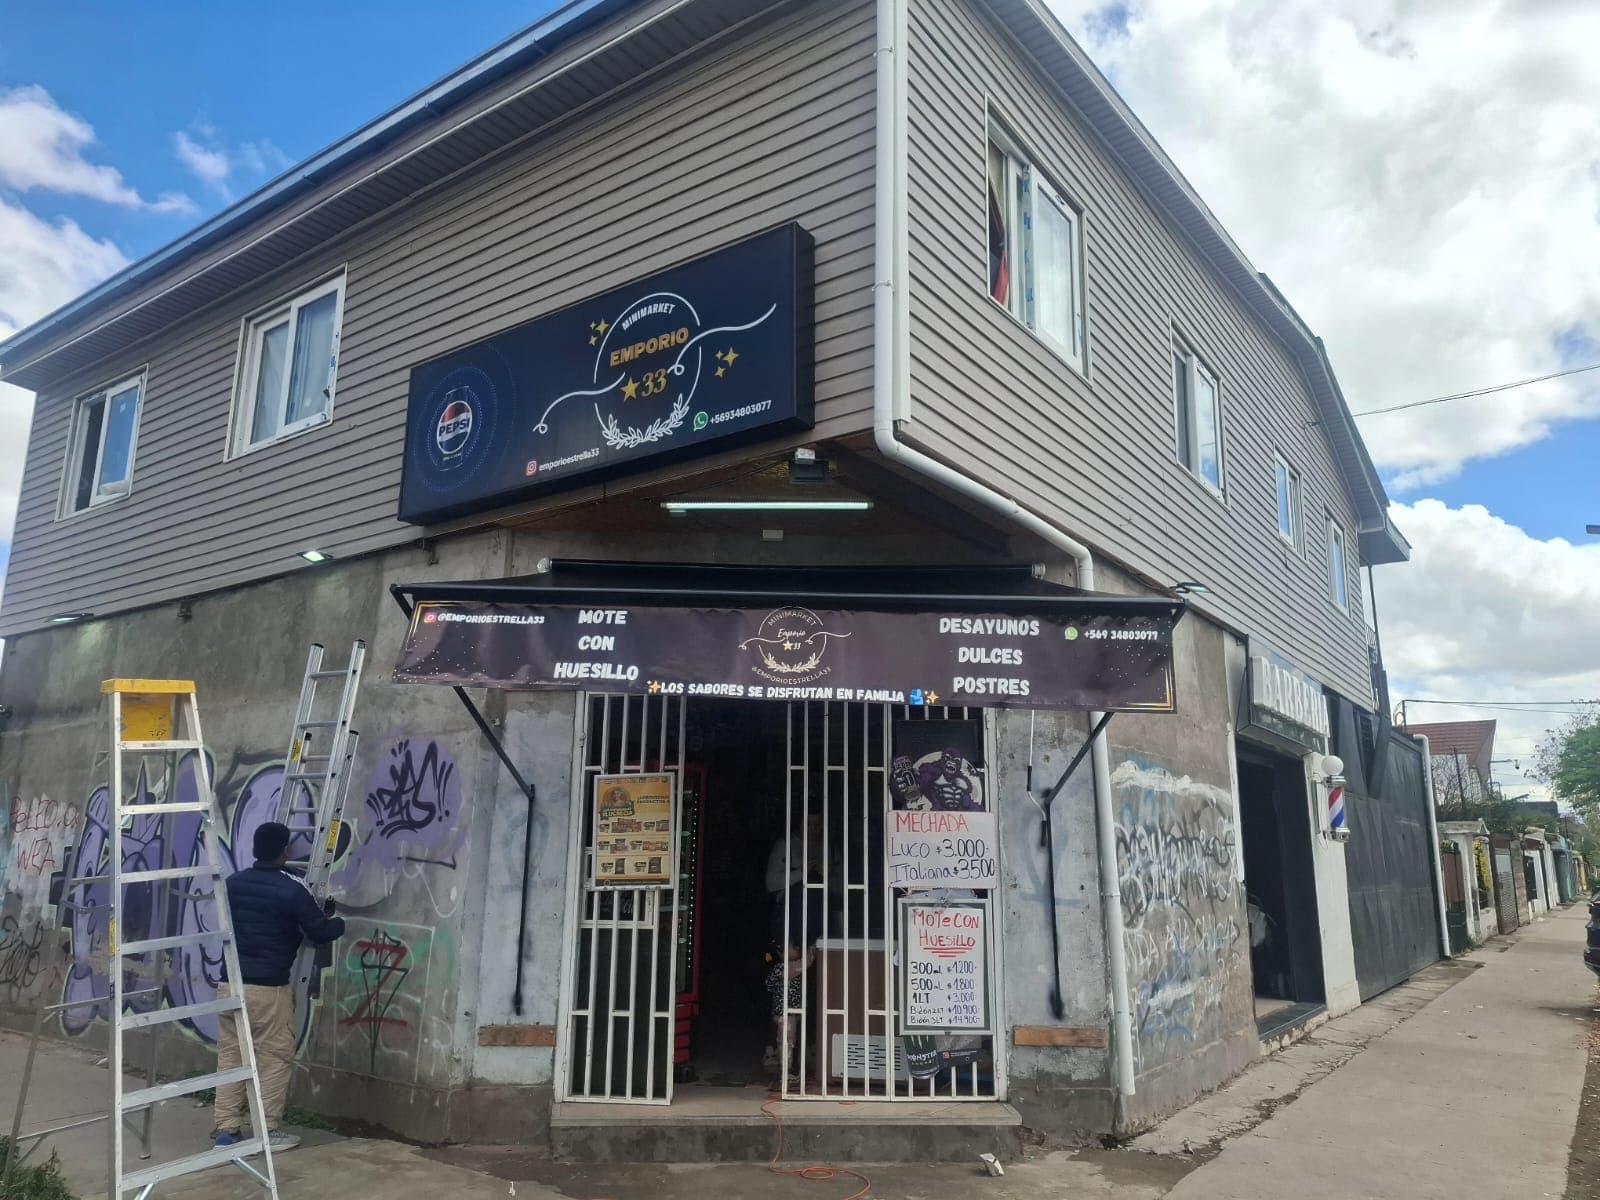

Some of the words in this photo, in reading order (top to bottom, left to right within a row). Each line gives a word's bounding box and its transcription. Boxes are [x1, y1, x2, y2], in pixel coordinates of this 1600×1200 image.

[621, 303, 676, 331] MINIMARKET
[609, 327, 689, 367] EMPORIO
[641, 368, 667, 397] 33
[710, 399, 772, 424] +56934803077
[439, 416, 471, 437] PEPSI
[538, 447, 600, 471] emporioestrella33
[578, 609, 627, 625] MOTE
[767, 610, 817, 626] MINIMARKET
[939, 618, 1041, 637] DESAYUNOS
[578, 635, 614, 651] CON
[1084, 628, 1108, 640] +569
[1110, 629, 1158, 641] 34803077
[957, 646, 1023, 666] DULCES
[553, 662, 640, 681] HUESILLO
[661, 682, 684, 694] LOS
[688, 683, 744, 697] SABORES
[748, 685, 763, 698] SE
[767, 686, 833, 700] DISFRUTAN
[836, 688, 853, 701] EN
[856, 689, 905, 703] FAMILIA
[953, 676, 1031, 697] POSTRES
[896, 811, 969, 833] MECHADA
[953, 912, 980, 929] CON
